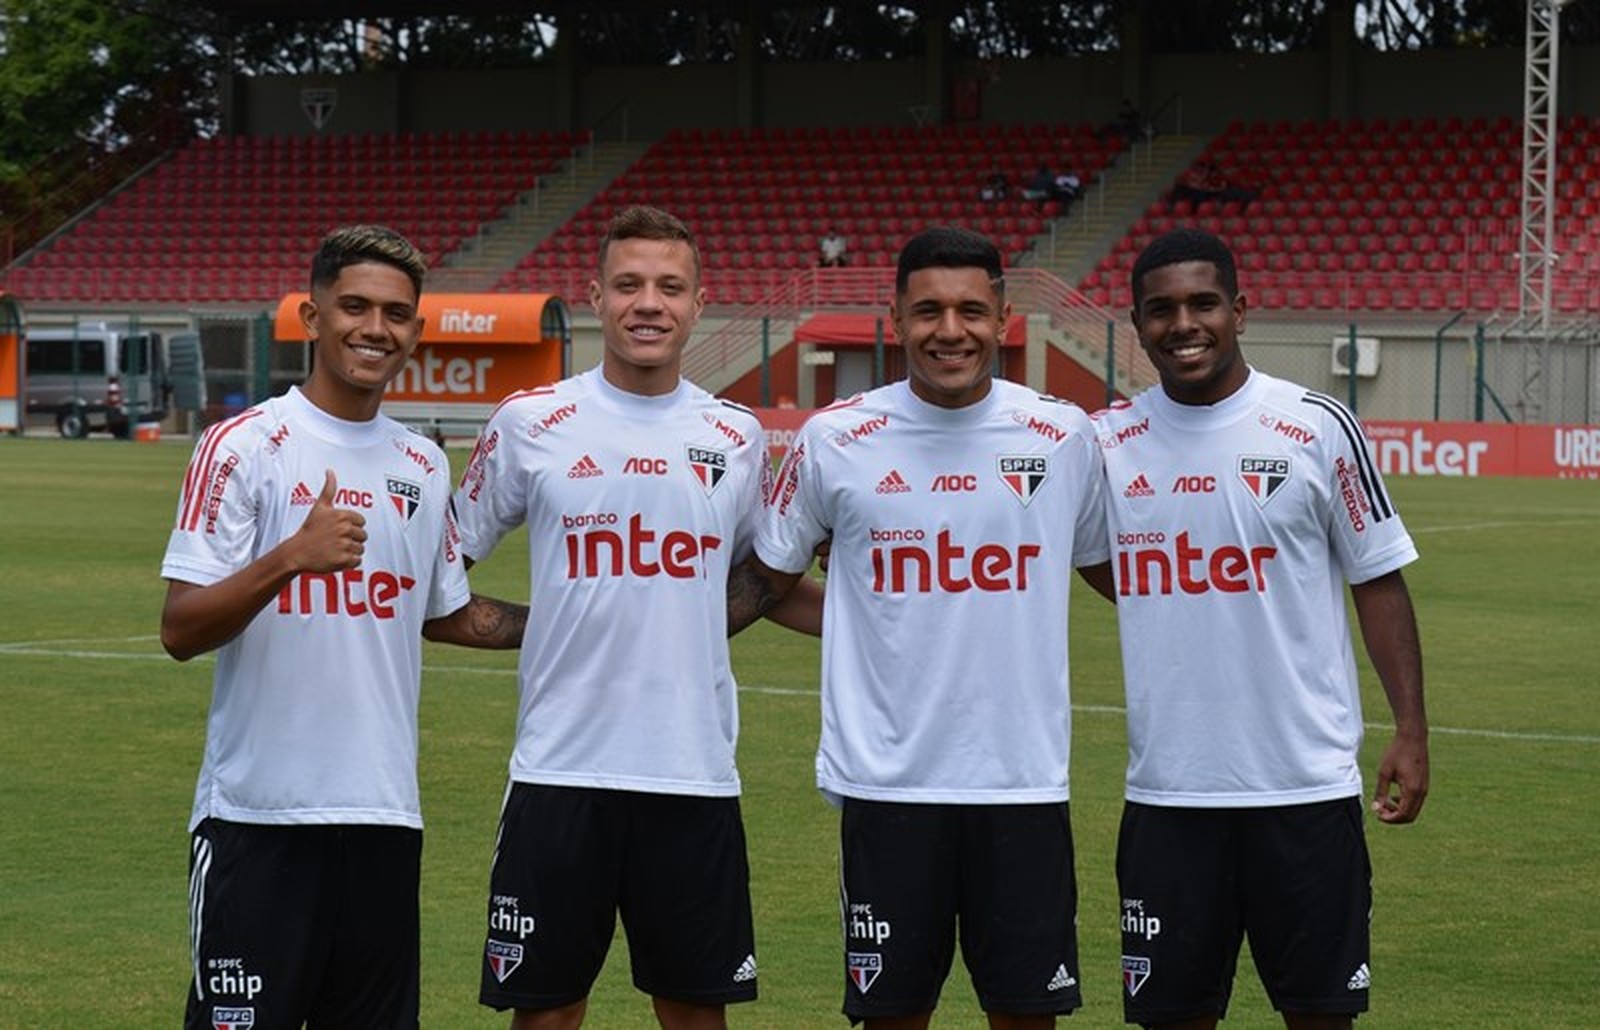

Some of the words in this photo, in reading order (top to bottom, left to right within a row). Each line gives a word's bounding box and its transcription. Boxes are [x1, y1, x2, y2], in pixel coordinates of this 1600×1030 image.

[441, 310, 497, 333] inter
[385, 347, 494, 393] nter
[541, 404, 577, 430] MRV
[849, 416, 889, 441] MRV
[1027, 416, 1067, 443] MRV
[715, 421, 746, 447] MRV
[1117, 418, 1149, 444] MRV
[1275, 420, 1315, 445] MRV
[690, 449, 726, 466] SPFC
[1001, 459, 1046, 472] SPFC
[1244, 460, 1288, 474] SPFC
[562, 513, 618, 529] banco
[566, 513, 722, 580] inter
[870, 528, 925, 542] banco
[1117, 532, 1166, 545] banco
[871, 529, 1041, 593] inter
[1118, 531, 1278, 596] inter
[490, 907, 535, 939] chip
[209, 970, 263, 1000] chip
